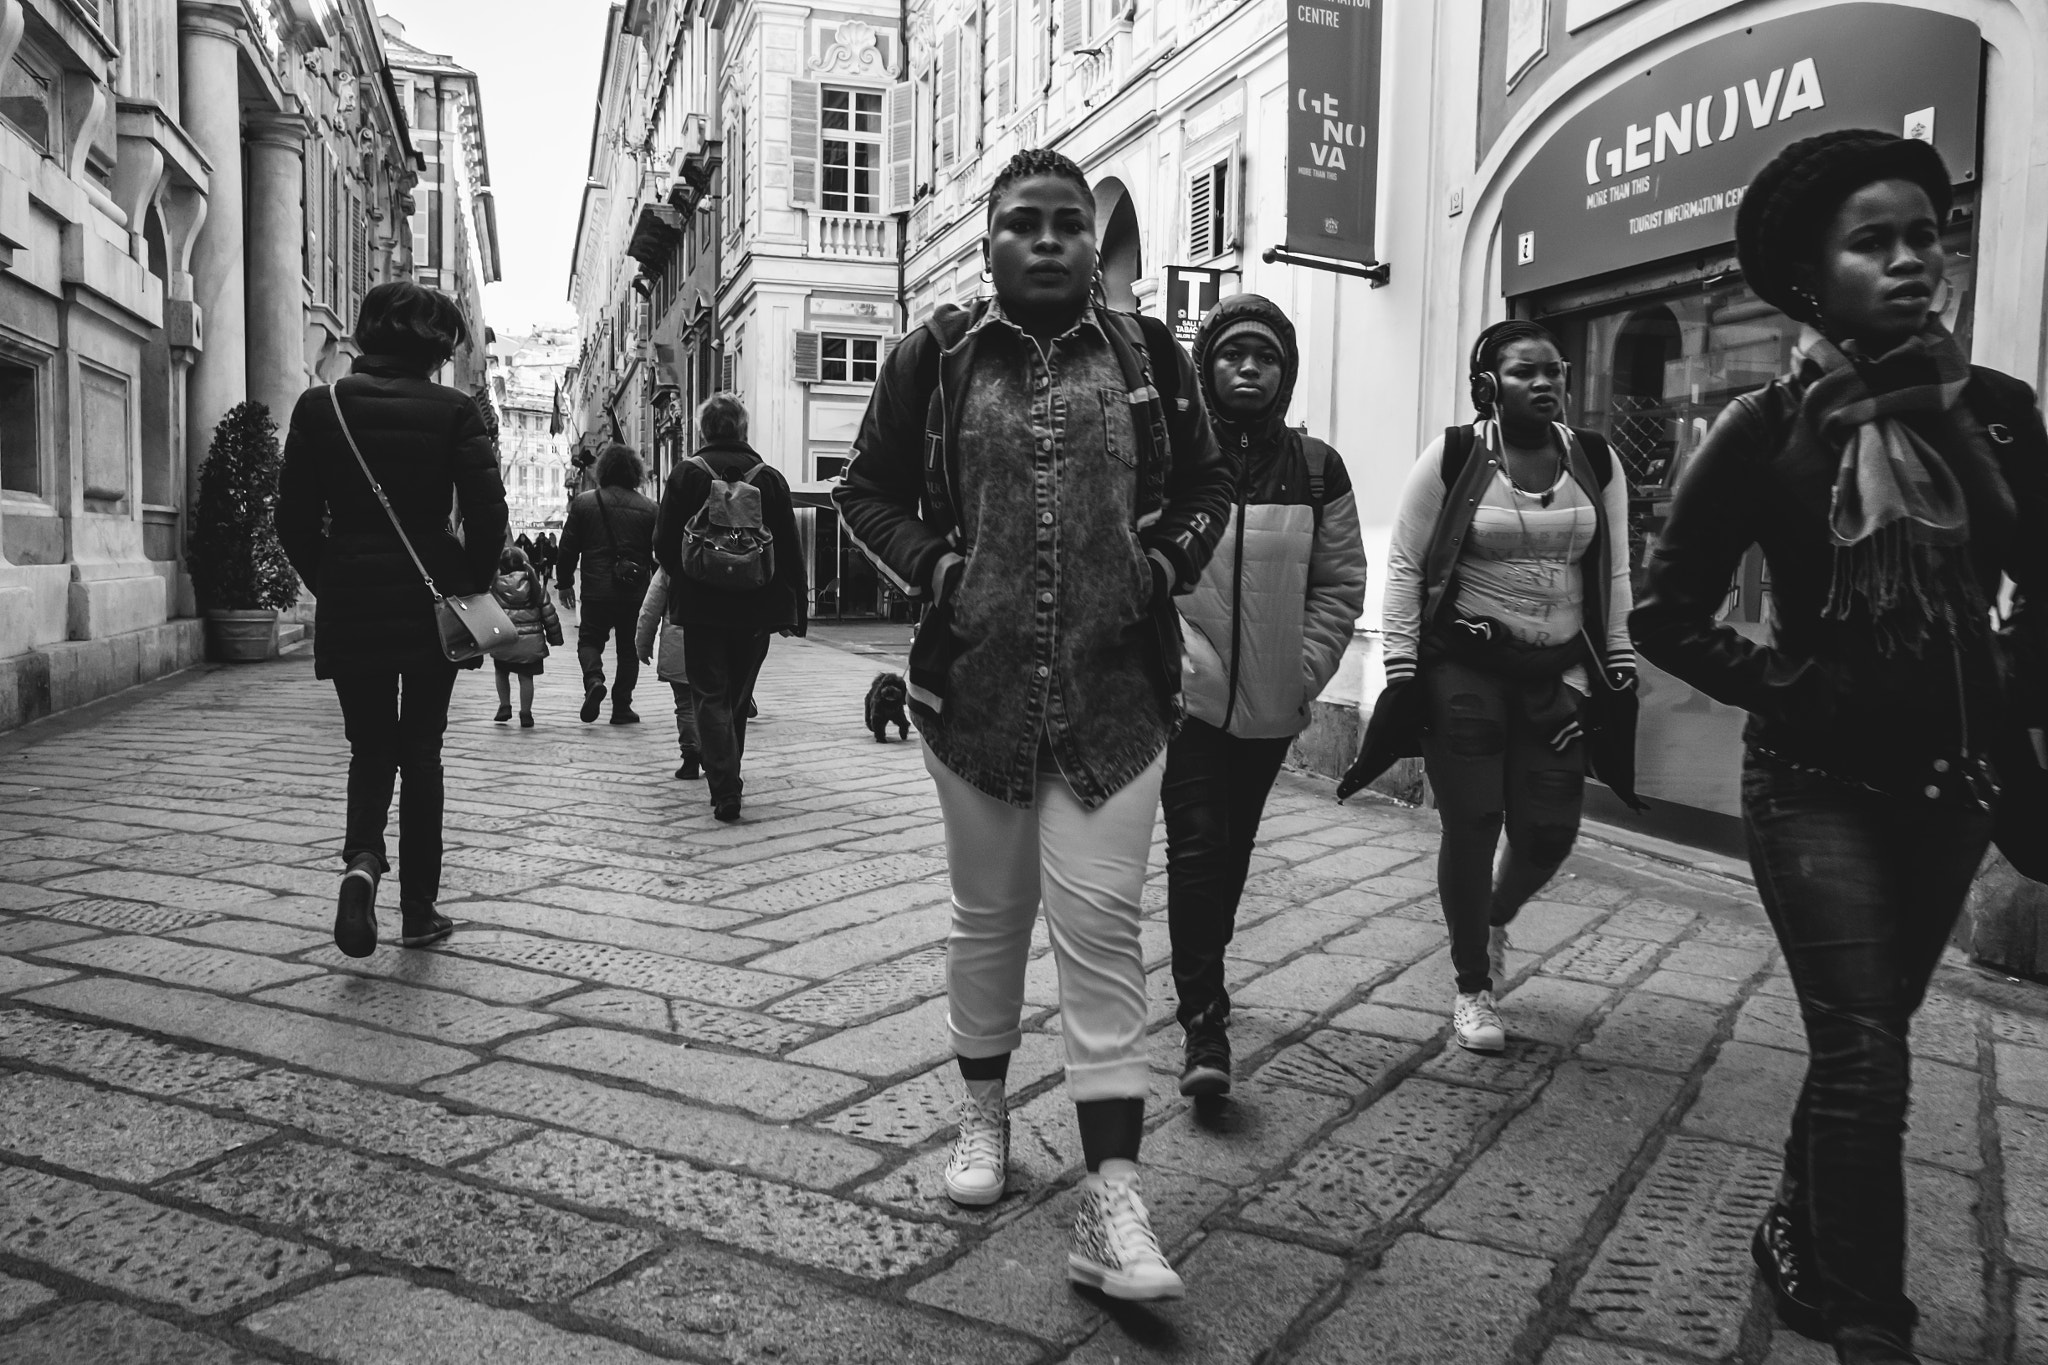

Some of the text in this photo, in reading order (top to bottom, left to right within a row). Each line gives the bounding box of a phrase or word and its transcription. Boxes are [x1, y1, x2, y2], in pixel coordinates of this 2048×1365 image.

[1298, 5, 1339, 28] CENTRE
[1585, 57, 1825, 185] GENOVA
[1586, 175, 1650, 210] MORE THAN THIS
[1629, 210, 1663, 235] TOURIST
[1664, 192, 1723, 225] INFORMATION
[1178, 271, 1211, 321] T
